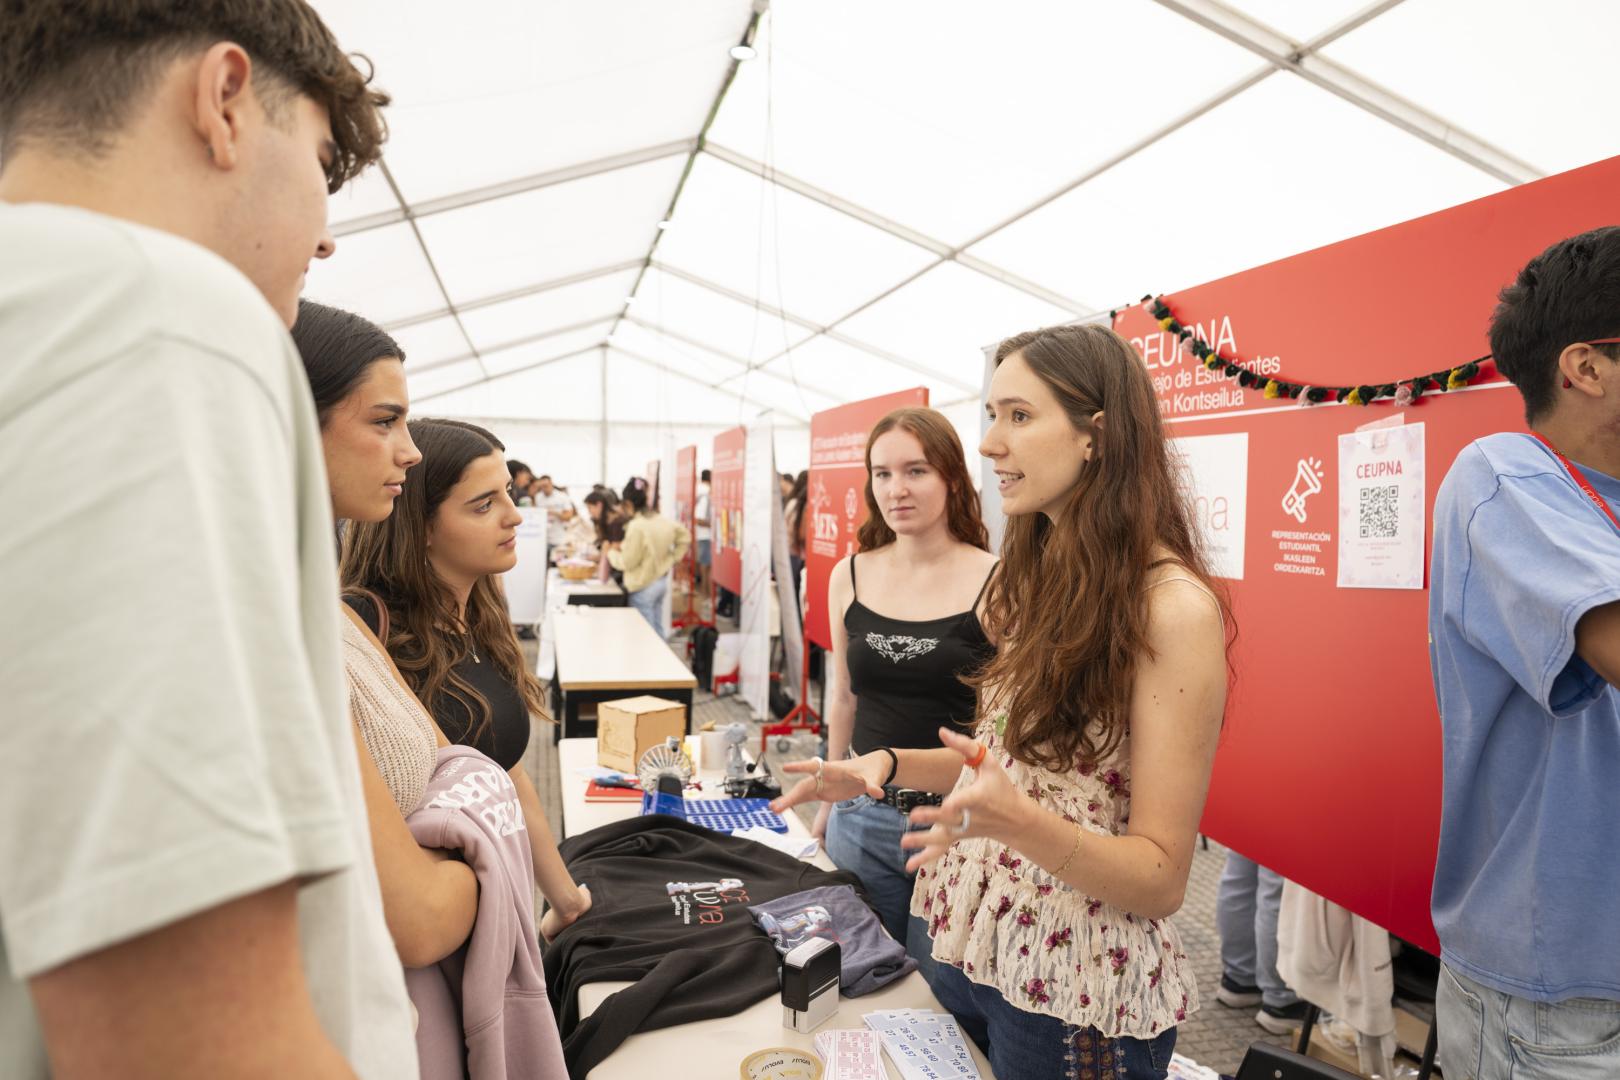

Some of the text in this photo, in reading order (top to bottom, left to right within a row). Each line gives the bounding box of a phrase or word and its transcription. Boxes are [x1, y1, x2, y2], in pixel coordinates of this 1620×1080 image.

[1175, 368, 1192, 389] de
[1195, 355, 1281, 386] Estuiantes
[1174, 386, 1244, 413] Kontseilua
[1357, 460, 1403, 480] CEUPNA
[1272, 530, 1330, 542] REPRESENTACIÓN
[1279, 541, 1322, 552] ESTUDIANTIL
[1283, 553, 1316, 564] IKASLEEN
[1274, 563, 1325, 576] ORDEZKARITZA
